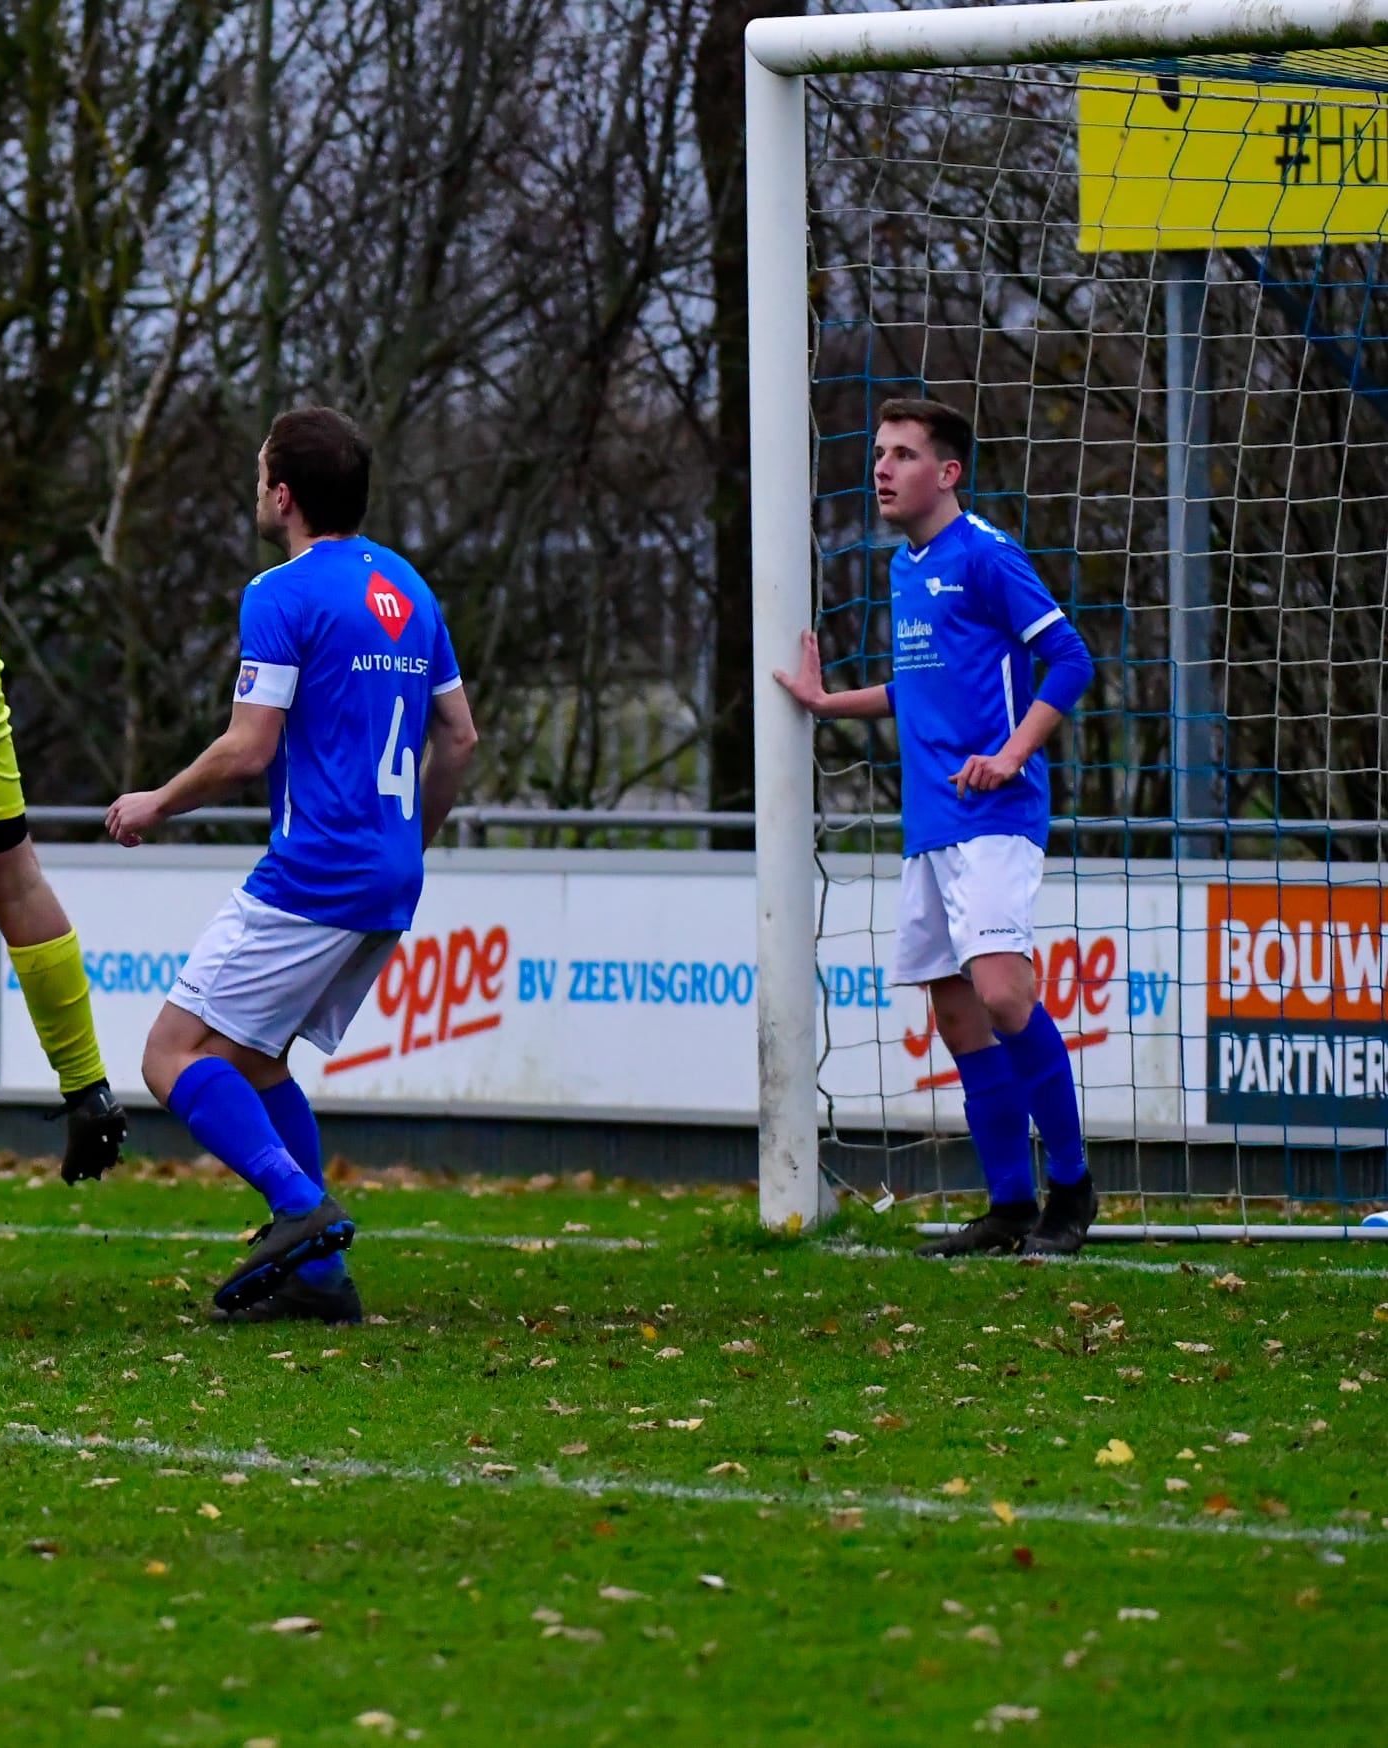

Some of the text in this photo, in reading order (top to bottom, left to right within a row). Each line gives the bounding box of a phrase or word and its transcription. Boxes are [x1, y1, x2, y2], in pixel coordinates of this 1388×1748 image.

[1275, 99, 1388, 185] #Hu
[374, 592, 400, 618] m
[351, 655, 391, 672] AUTO
[377, 695, 415, 821] 4
[377, 924, 508, 1056] oppe
[519, 958, 556, 1002] BV
[1128, 970, 1169, 1016] BV
[1220, 918, 1388, 1005] BOUW
[1219, 1032, 1388, 1098] PARTNER
